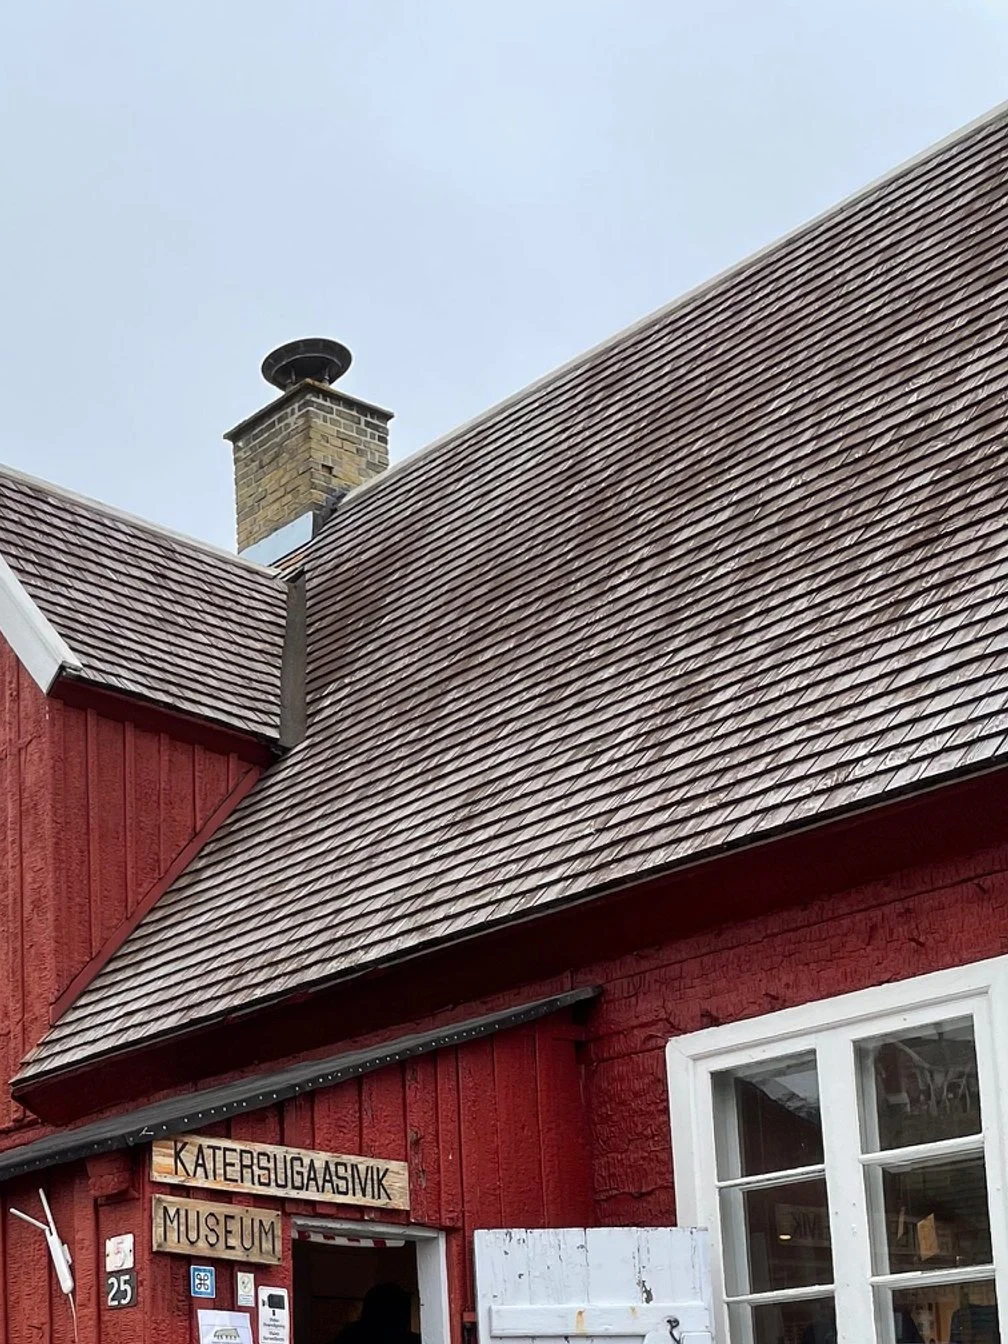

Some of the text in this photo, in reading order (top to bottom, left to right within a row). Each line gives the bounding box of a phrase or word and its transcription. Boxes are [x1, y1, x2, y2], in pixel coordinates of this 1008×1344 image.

[173, 1140, 392, 1201] KATERSUGAASIVIK
[162, 1205, 277, 1255] MUSEUM
[107, 1274, 132, 1307] 25
